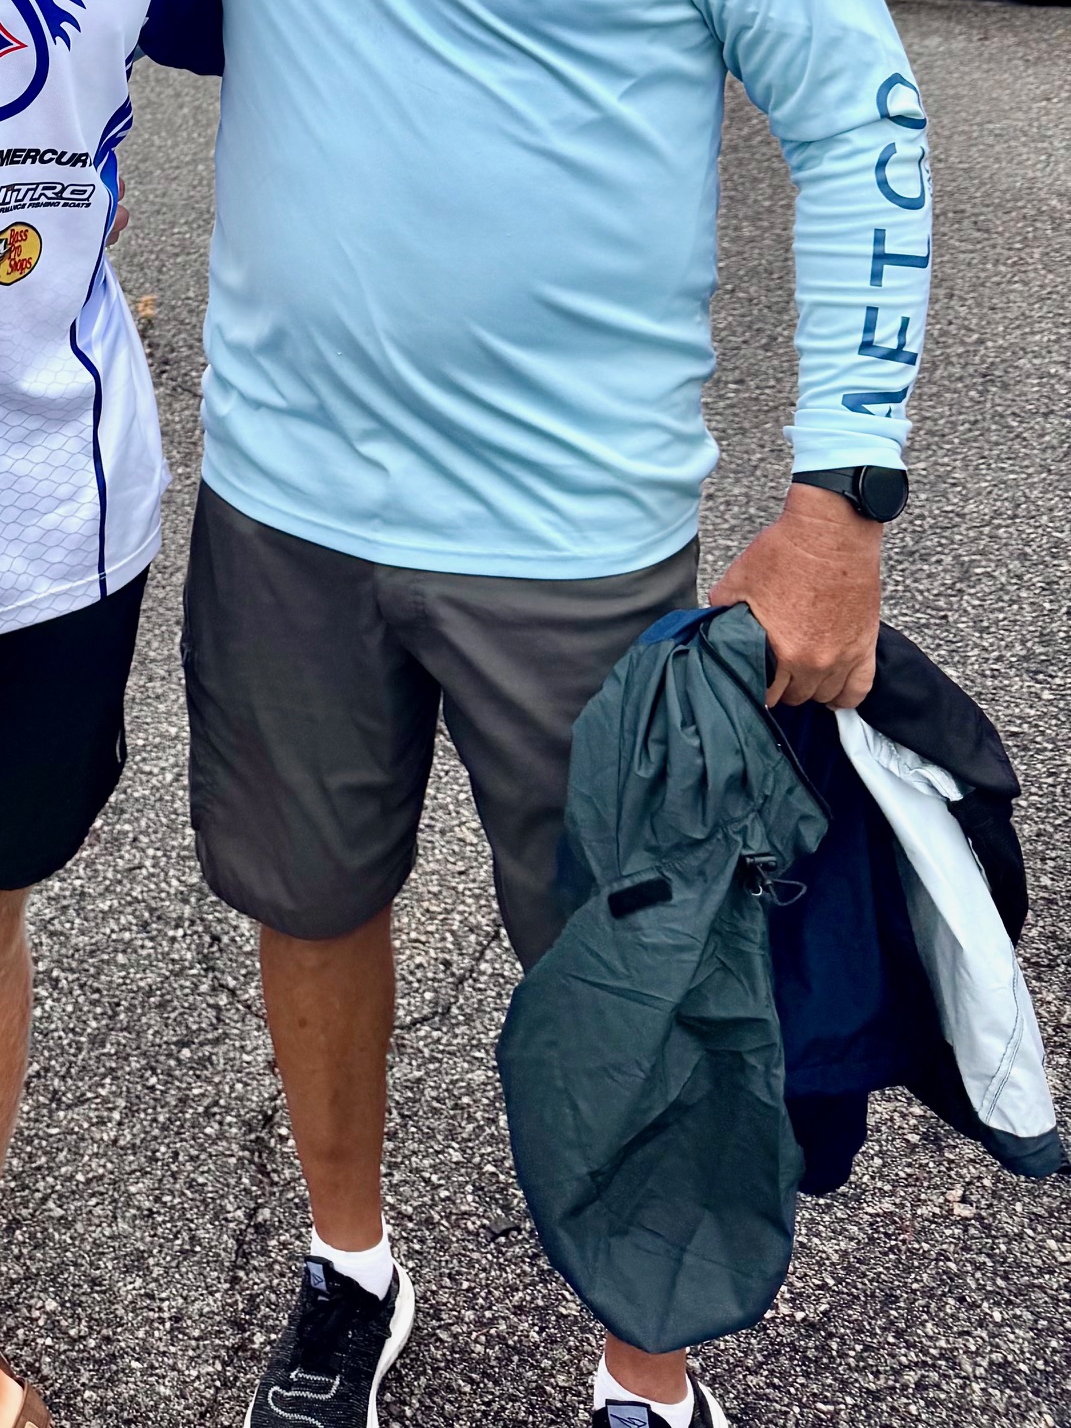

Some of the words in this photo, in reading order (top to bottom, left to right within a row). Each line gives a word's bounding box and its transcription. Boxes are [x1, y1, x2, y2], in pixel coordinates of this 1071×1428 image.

[26, 201, 61, 209] FISHING
[61, 201, 92, 209] BOATS
[8, 228, 29, 246] Bass
[8, 243, 23, 261] Pro
[6, 256, 32, 275] Shops
